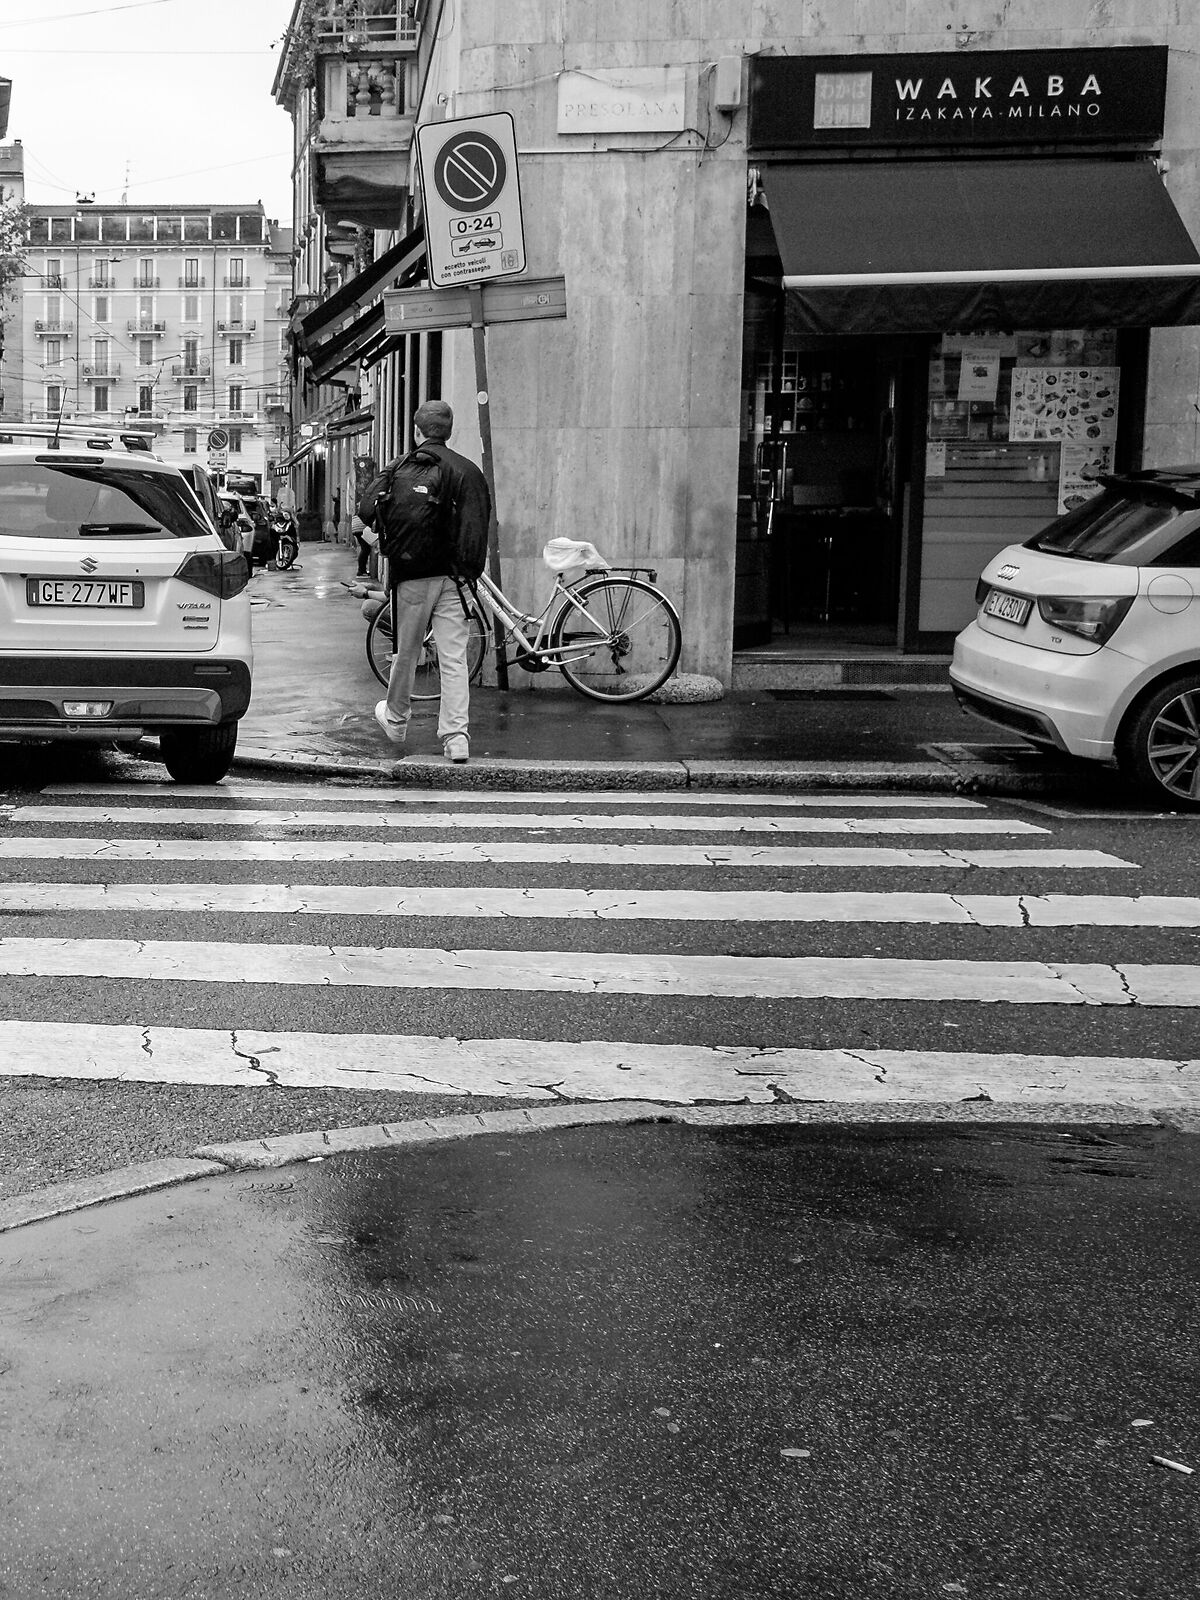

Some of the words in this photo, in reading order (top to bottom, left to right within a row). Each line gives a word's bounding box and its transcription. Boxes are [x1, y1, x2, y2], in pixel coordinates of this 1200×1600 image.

[895, 74, 1102, 100] WAKABA
[565, 102, 679, 117] PRESOLANA
[457, 216, 493, 233] 0-24
[444, 261, 466, 270] eccetto
[468, 257, 486, 266] veicoli
[453, 265, 491, 276] contrassegno
